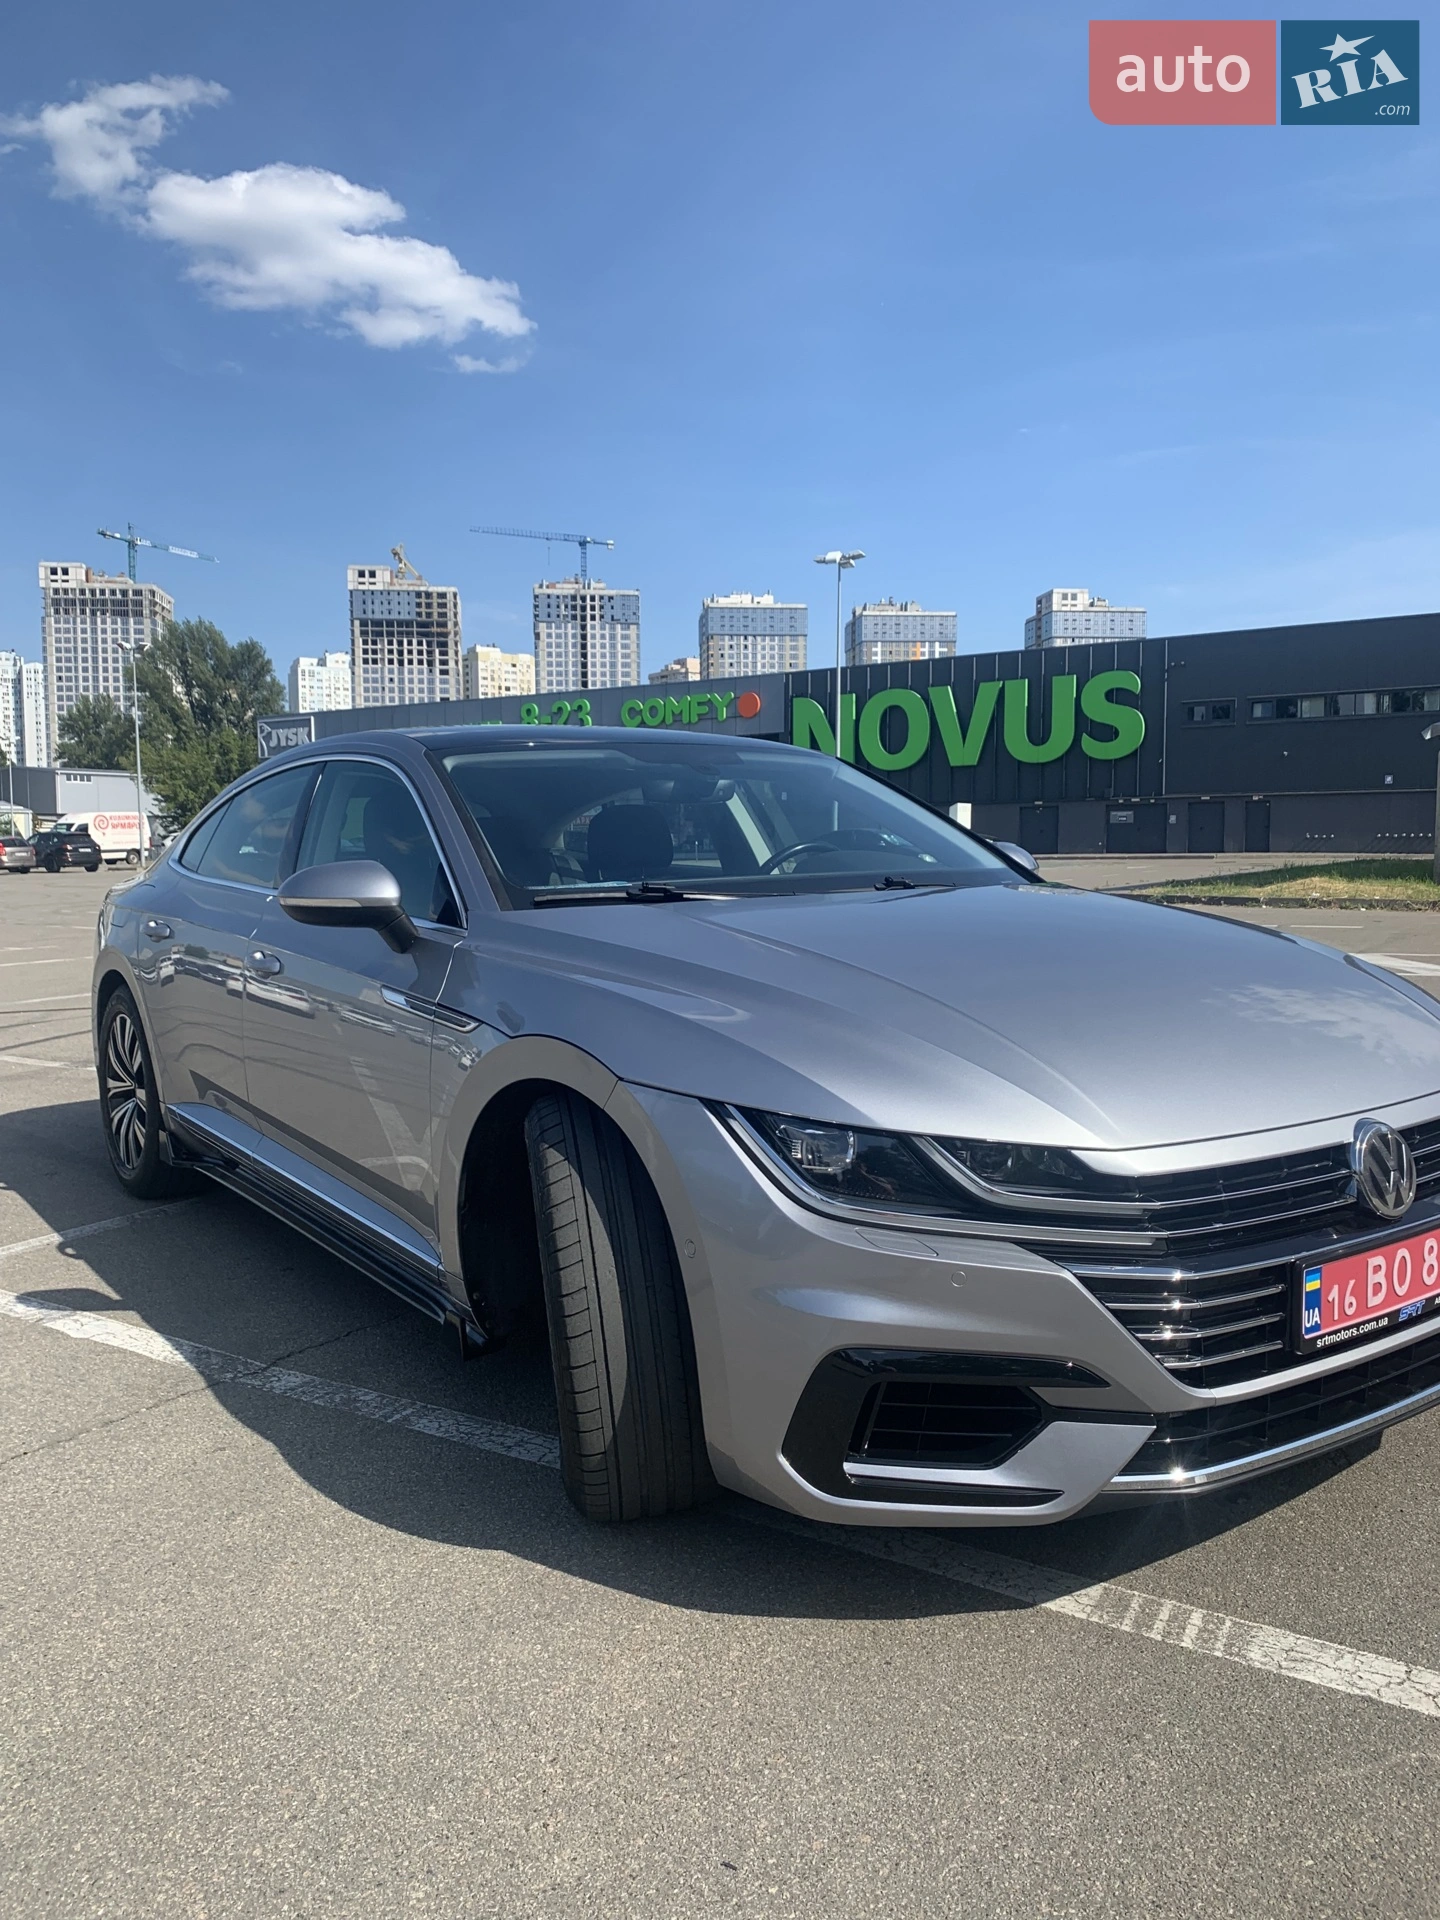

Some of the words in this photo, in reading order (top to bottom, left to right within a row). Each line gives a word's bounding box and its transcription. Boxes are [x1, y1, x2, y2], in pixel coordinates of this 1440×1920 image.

[520, 699, 592, 726] 8-23
[621, 691, 735, 727] COMFY
[792, 670, 1145, 771] NOVUS
[269, 726, 309, 748] JYSK
[1327, 1279, 1357, 1321] 16
[1305, 1307, 1321, 1328] UA
[1316, 1317, 1389, 1348] srtmotors.com.ua
